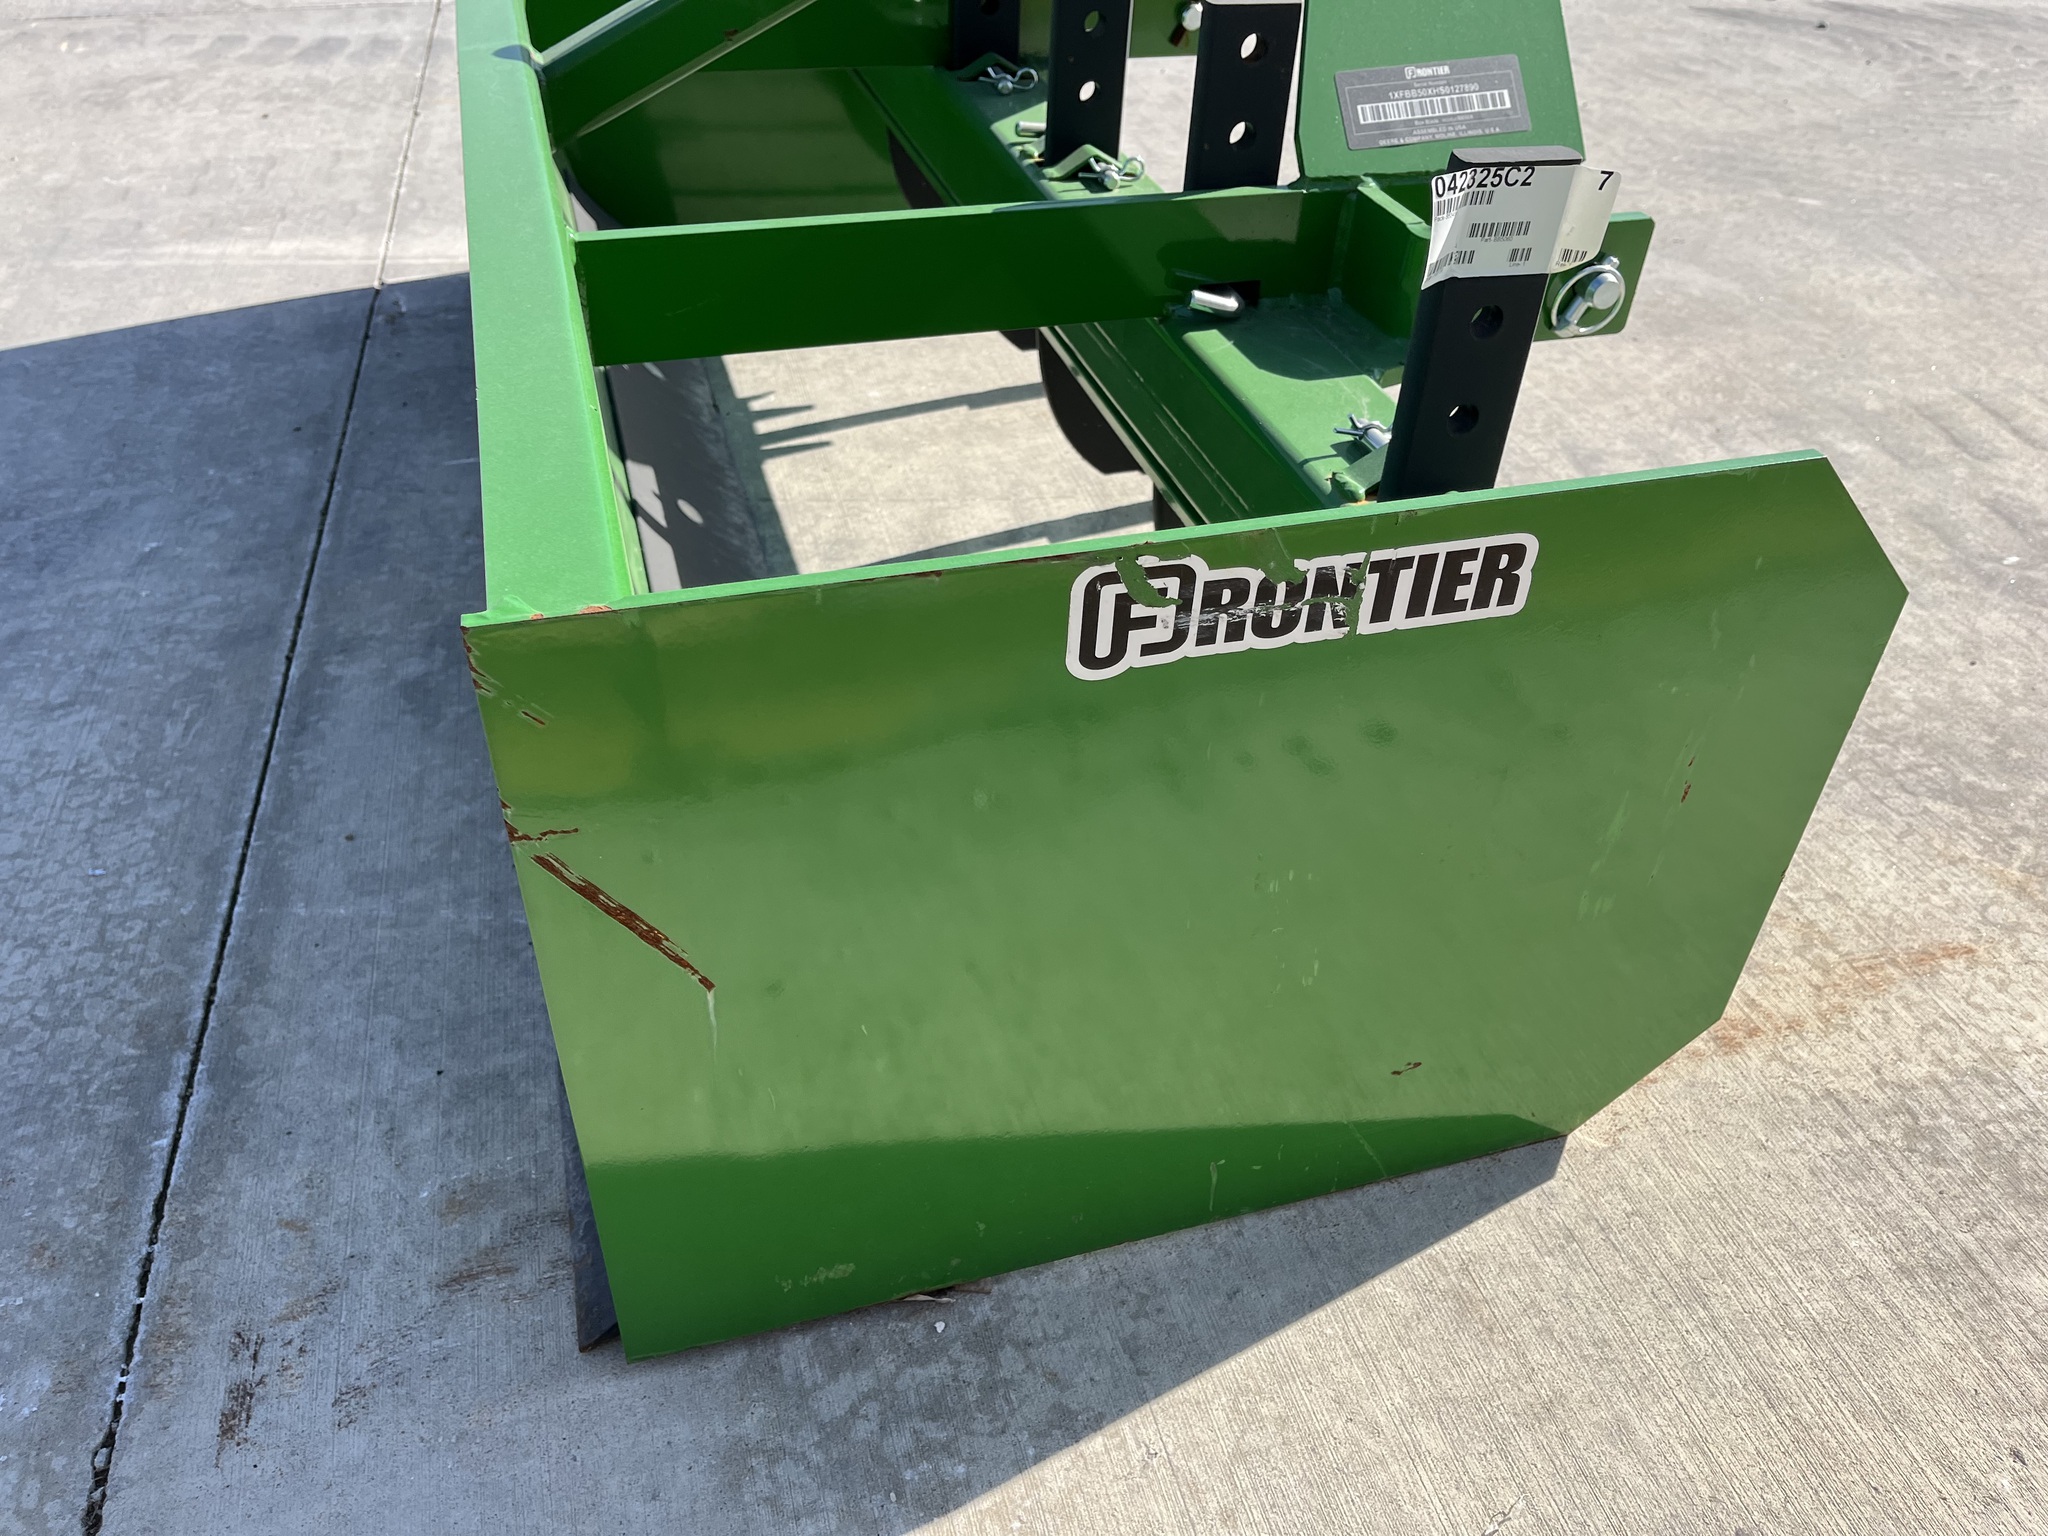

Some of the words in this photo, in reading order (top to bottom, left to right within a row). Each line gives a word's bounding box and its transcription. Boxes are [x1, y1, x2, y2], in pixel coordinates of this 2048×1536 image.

[1404, 65, 1450, 79] FRONTIER
[1434, 166, 1536, 198] 042325C2
[1597, 170, 1615, 191] 7
[1076, 539, 1530, 673] FRONTIER
